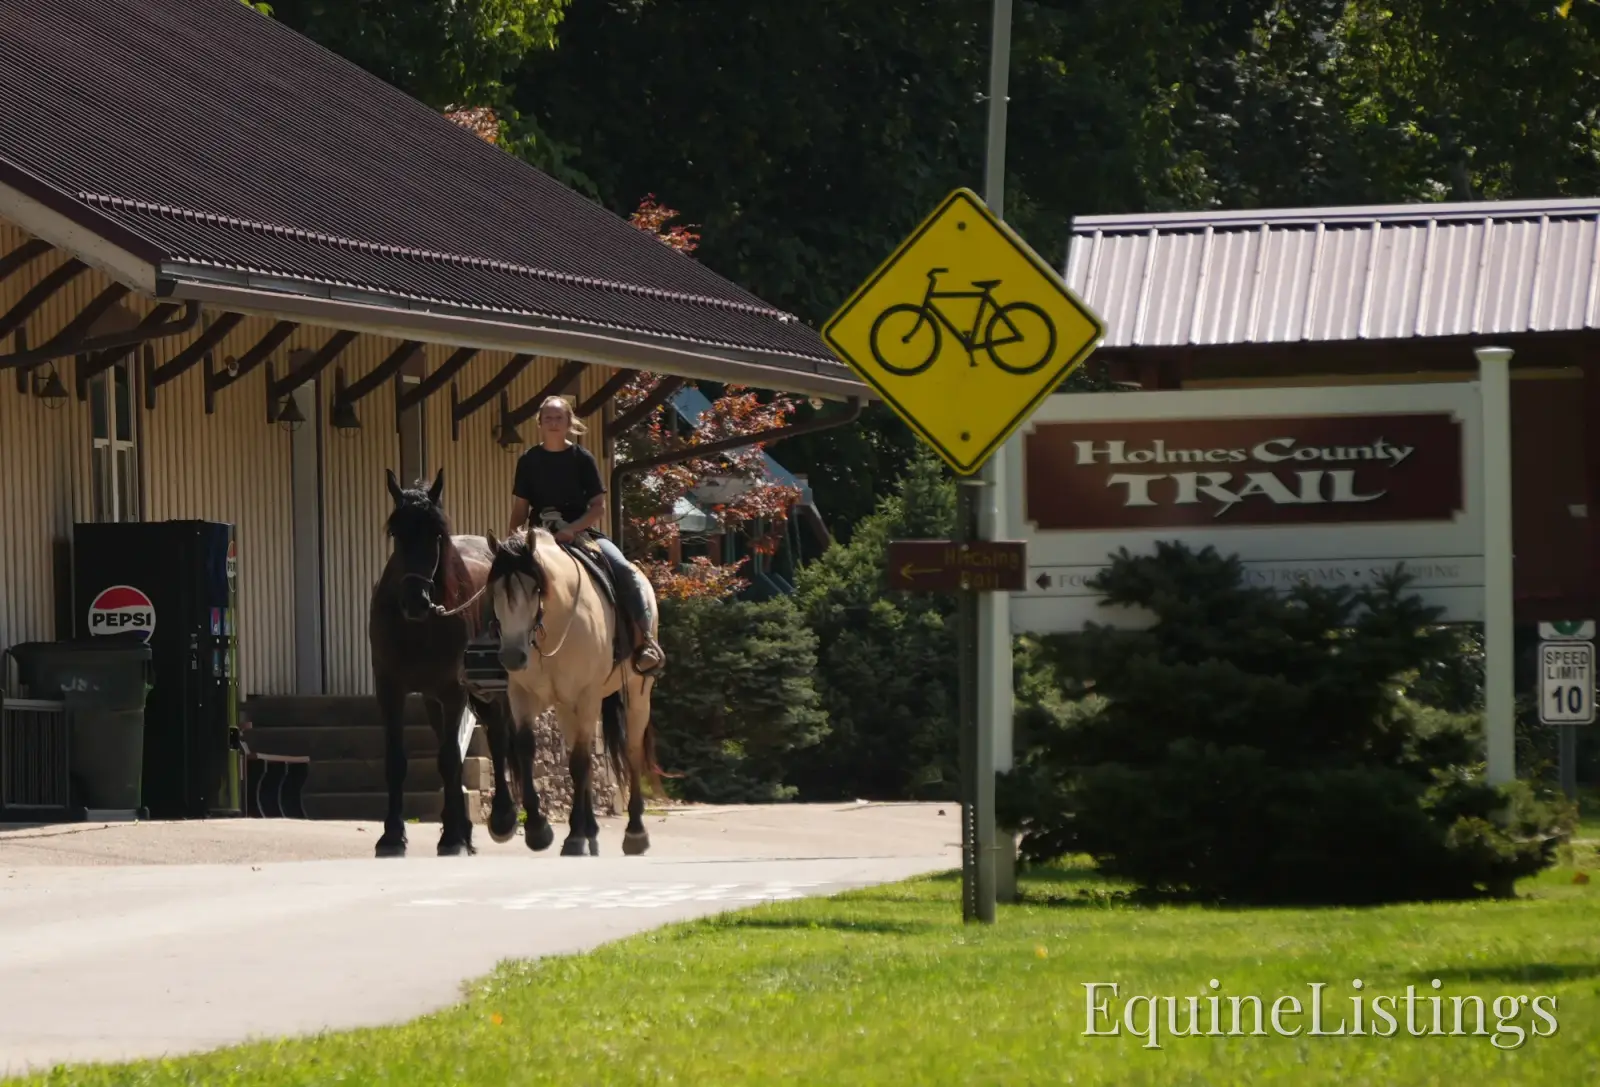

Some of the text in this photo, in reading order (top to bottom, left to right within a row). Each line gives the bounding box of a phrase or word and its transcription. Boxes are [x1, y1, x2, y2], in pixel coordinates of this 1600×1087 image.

[1072, 437, 1415, 467] Holmes County
[1106, 470, 1387, 517] TRAIL
[92, 612, 152, 627] PEPSI
[1545, 651, 1589, 665] SPEED
[1547, 666, 1586, 680] LIMIT
[1551, 685, 1583, 714] 10
